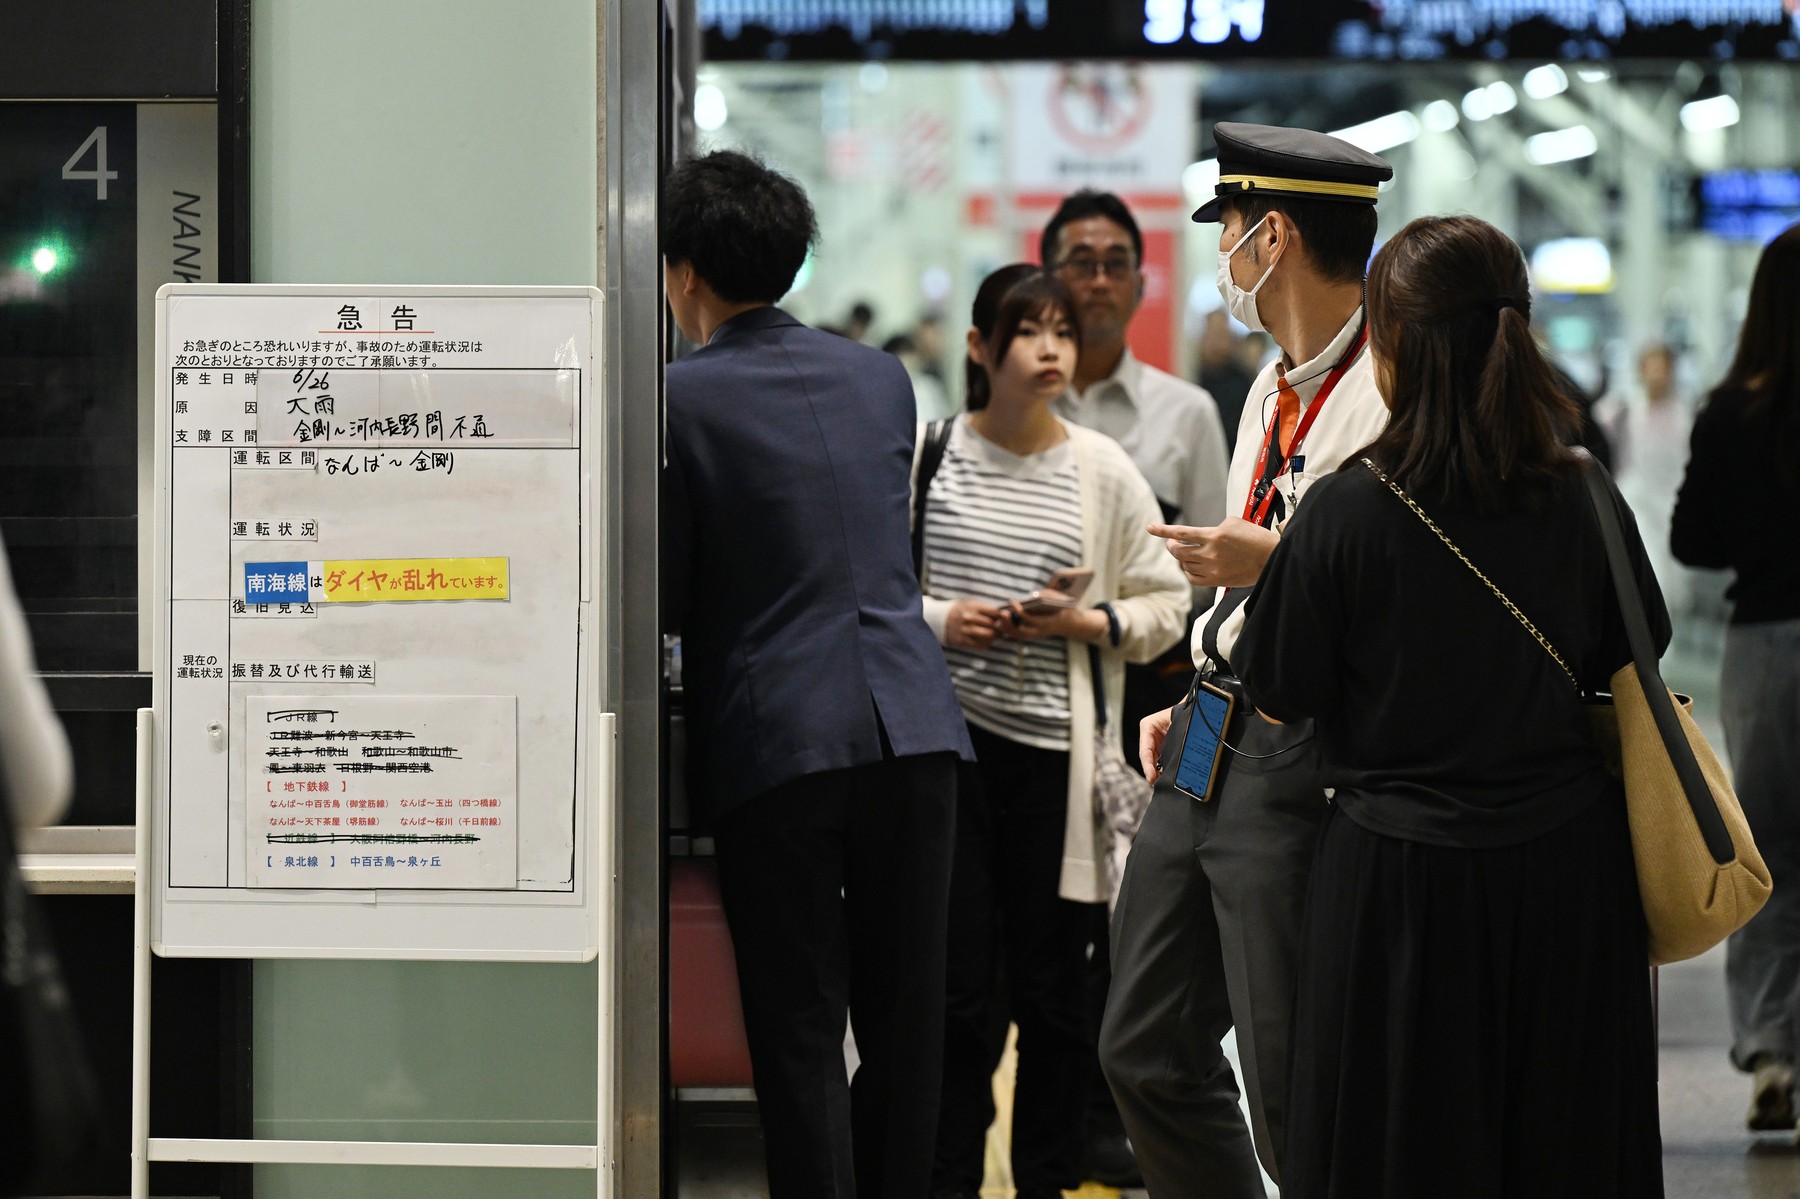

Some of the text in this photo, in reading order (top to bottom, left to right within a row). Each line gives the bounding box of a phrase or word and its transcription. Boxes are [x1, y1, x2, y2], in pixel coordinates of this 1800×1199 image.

[61, 126, 118, 200] 4
[337, 304, 417, 331] 急告
[183, 339, 483, 354] お急ぎのところ恐れいりますが、事故のため運転状況は
[175, 354, 437, 368] 次のとおりとなっておりますのでご了承願います。
[175, 372, 257, 386] 発生日時
[286, 394, 335, 416] 大雨
[175, 429, 257, 443] 支障区間
[233, 450, 315, 466] 運転区間
[233, 521, 315, 537] 運転状況
[183, 655, 217, 666] 現在の
[177, 667, 223, 679] 運転状況
[231, 663, 373, 680] 振替及び代行輸送
